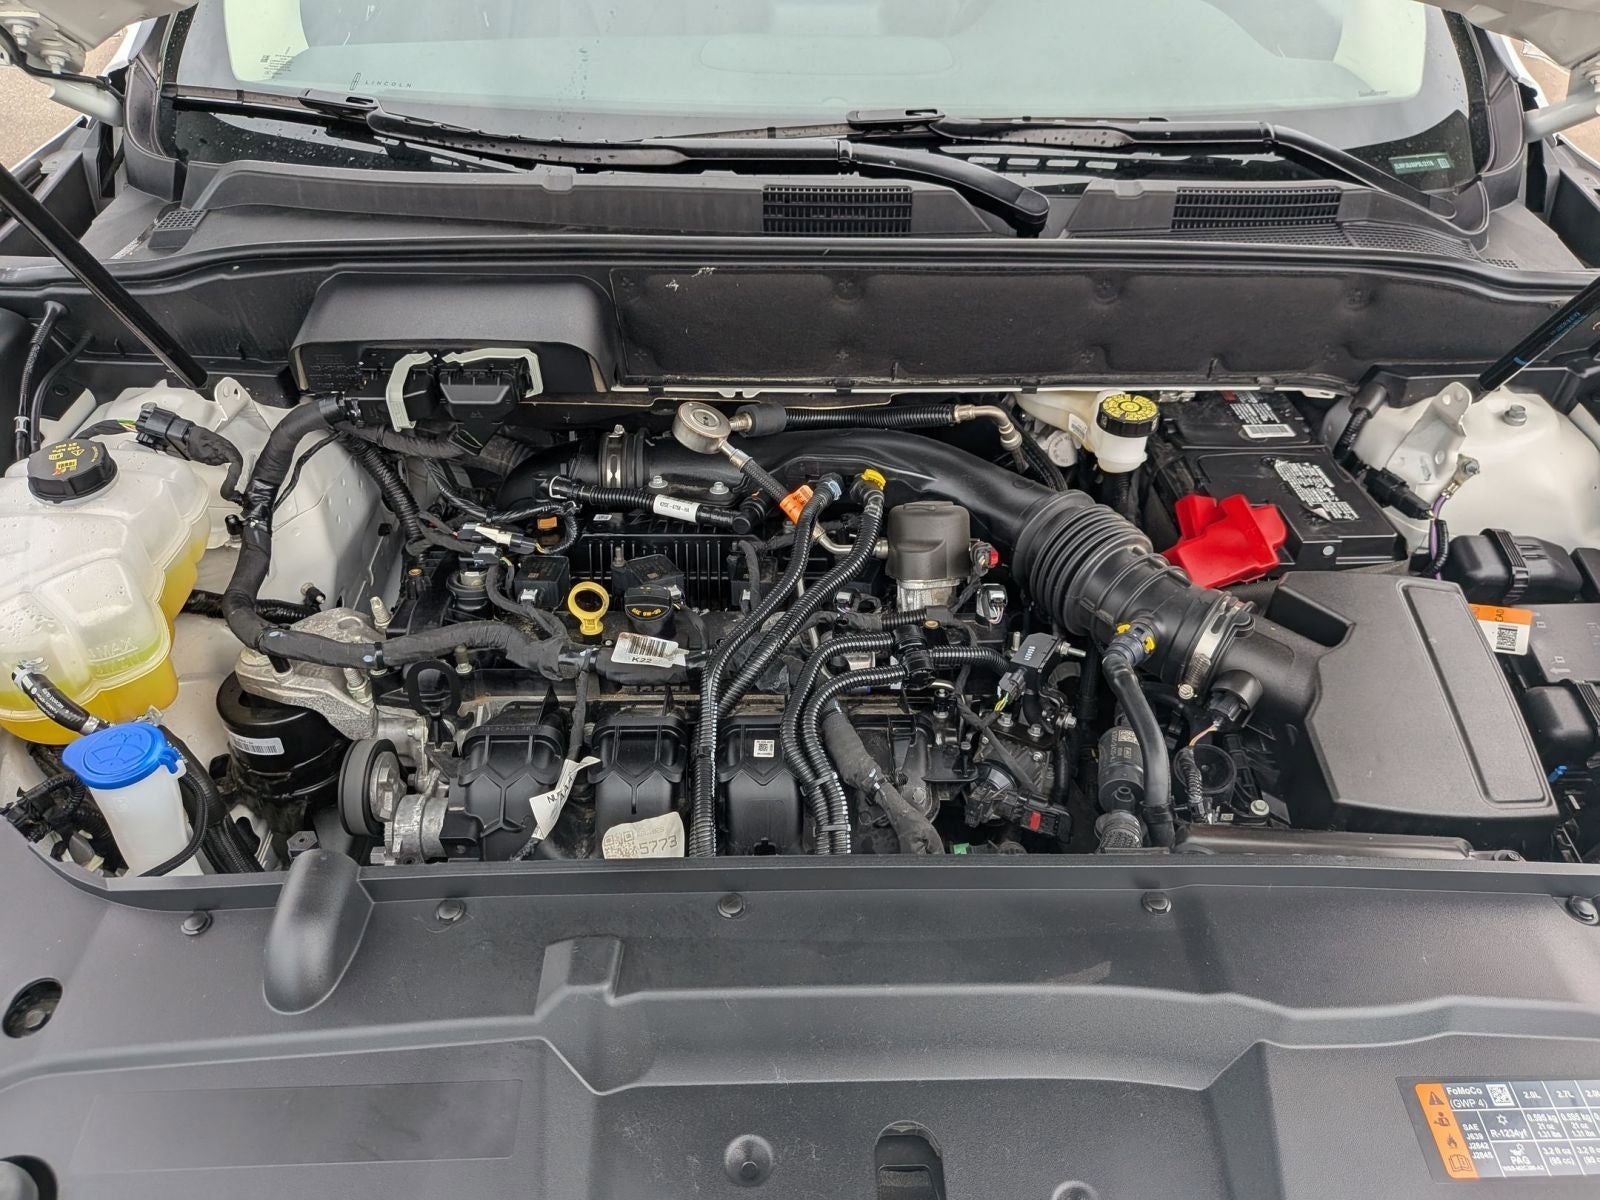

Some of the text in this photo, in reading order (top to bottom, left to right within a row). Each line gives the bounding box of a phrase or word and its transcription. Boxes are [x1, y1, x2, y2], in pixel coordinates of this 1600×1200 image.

[638, 834, 678, 855] 5773
[1446, 1086, 1483, 1095] FoMoCo
[1449, 1098, 1488, 1109] (GWP 4)
[1462, 1123, 1480, 1131] SAE
[1490, 1129, 1528, 1139] R-1234yf
[1510, 1156, 1531, 1165] PAG
